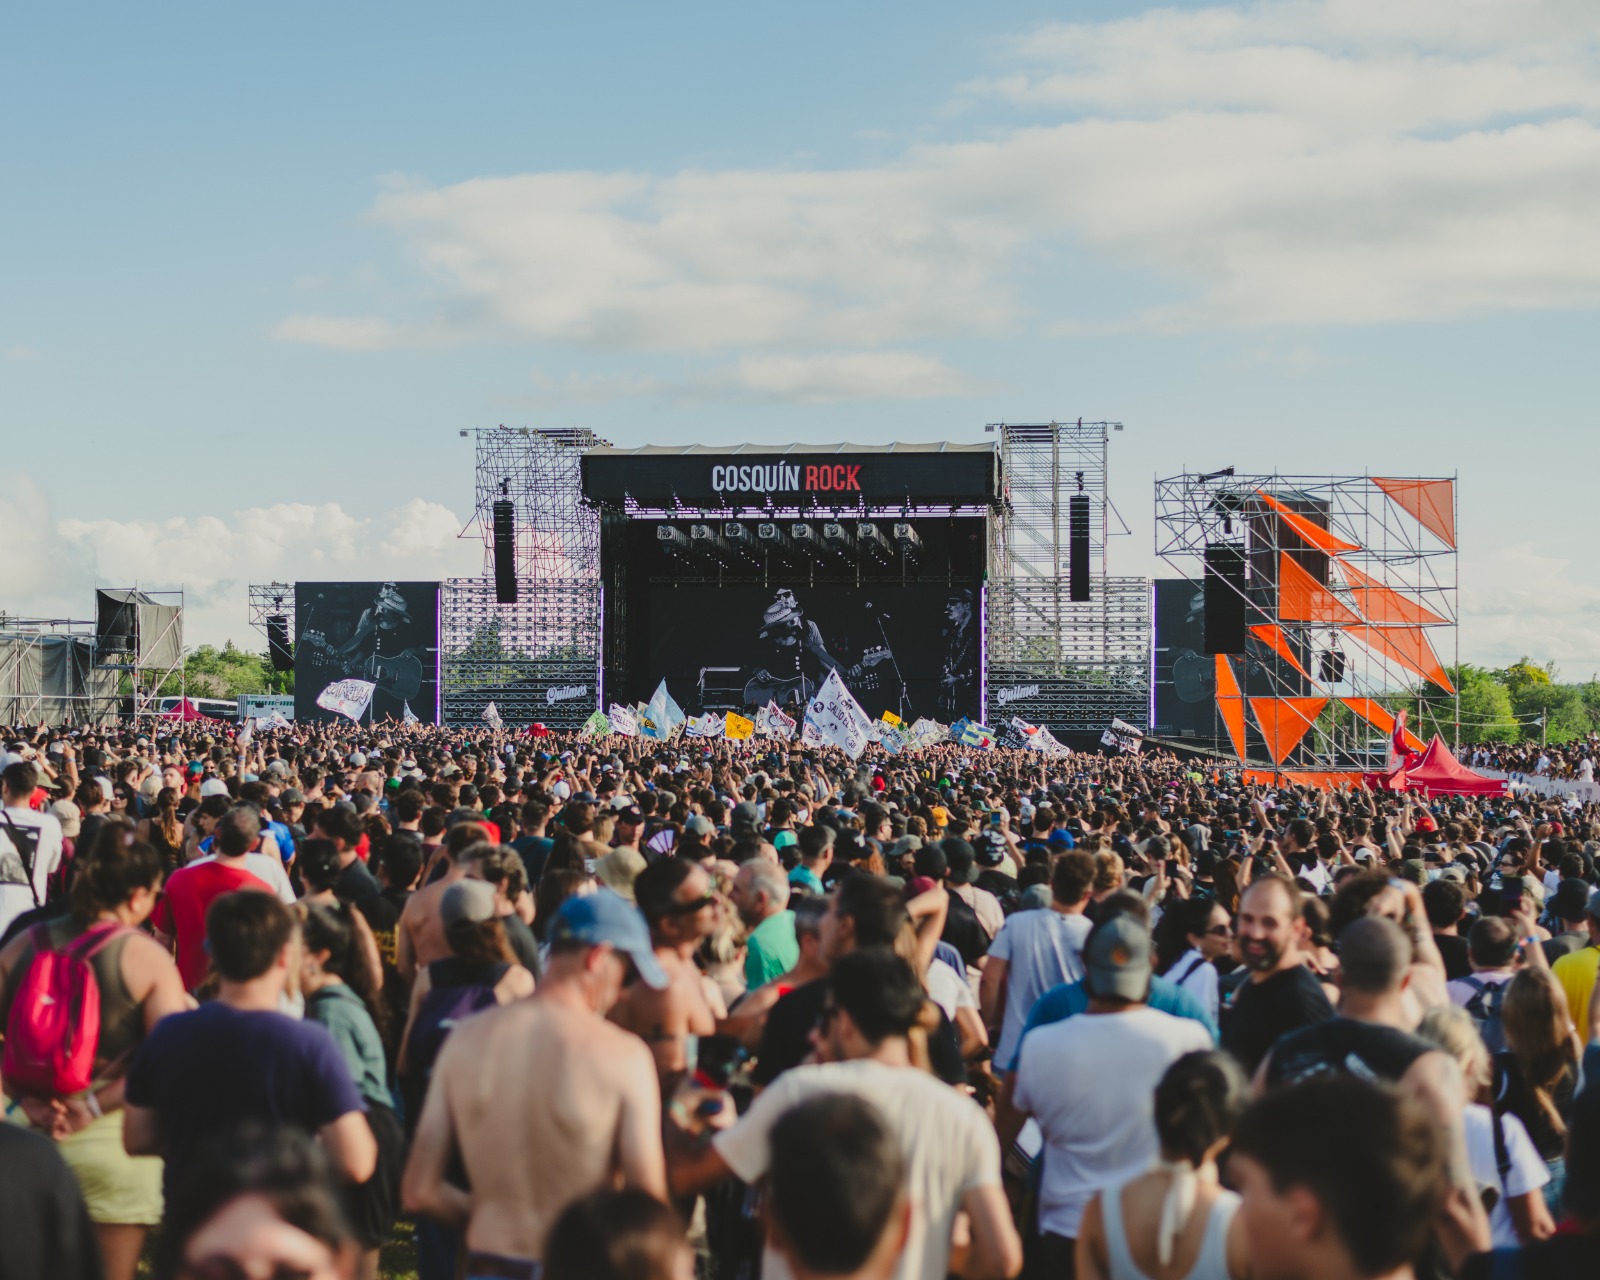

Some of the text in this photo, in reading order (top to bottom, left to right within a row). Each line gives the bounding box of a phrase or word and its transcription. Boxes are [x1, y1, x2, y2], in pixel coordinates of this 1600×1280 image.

[712, 460, 862, 493] COSQUÍN ROCK
[546, 685, 588, 705] Quilmes
[996, 684, 1040, 706] Quilmes
